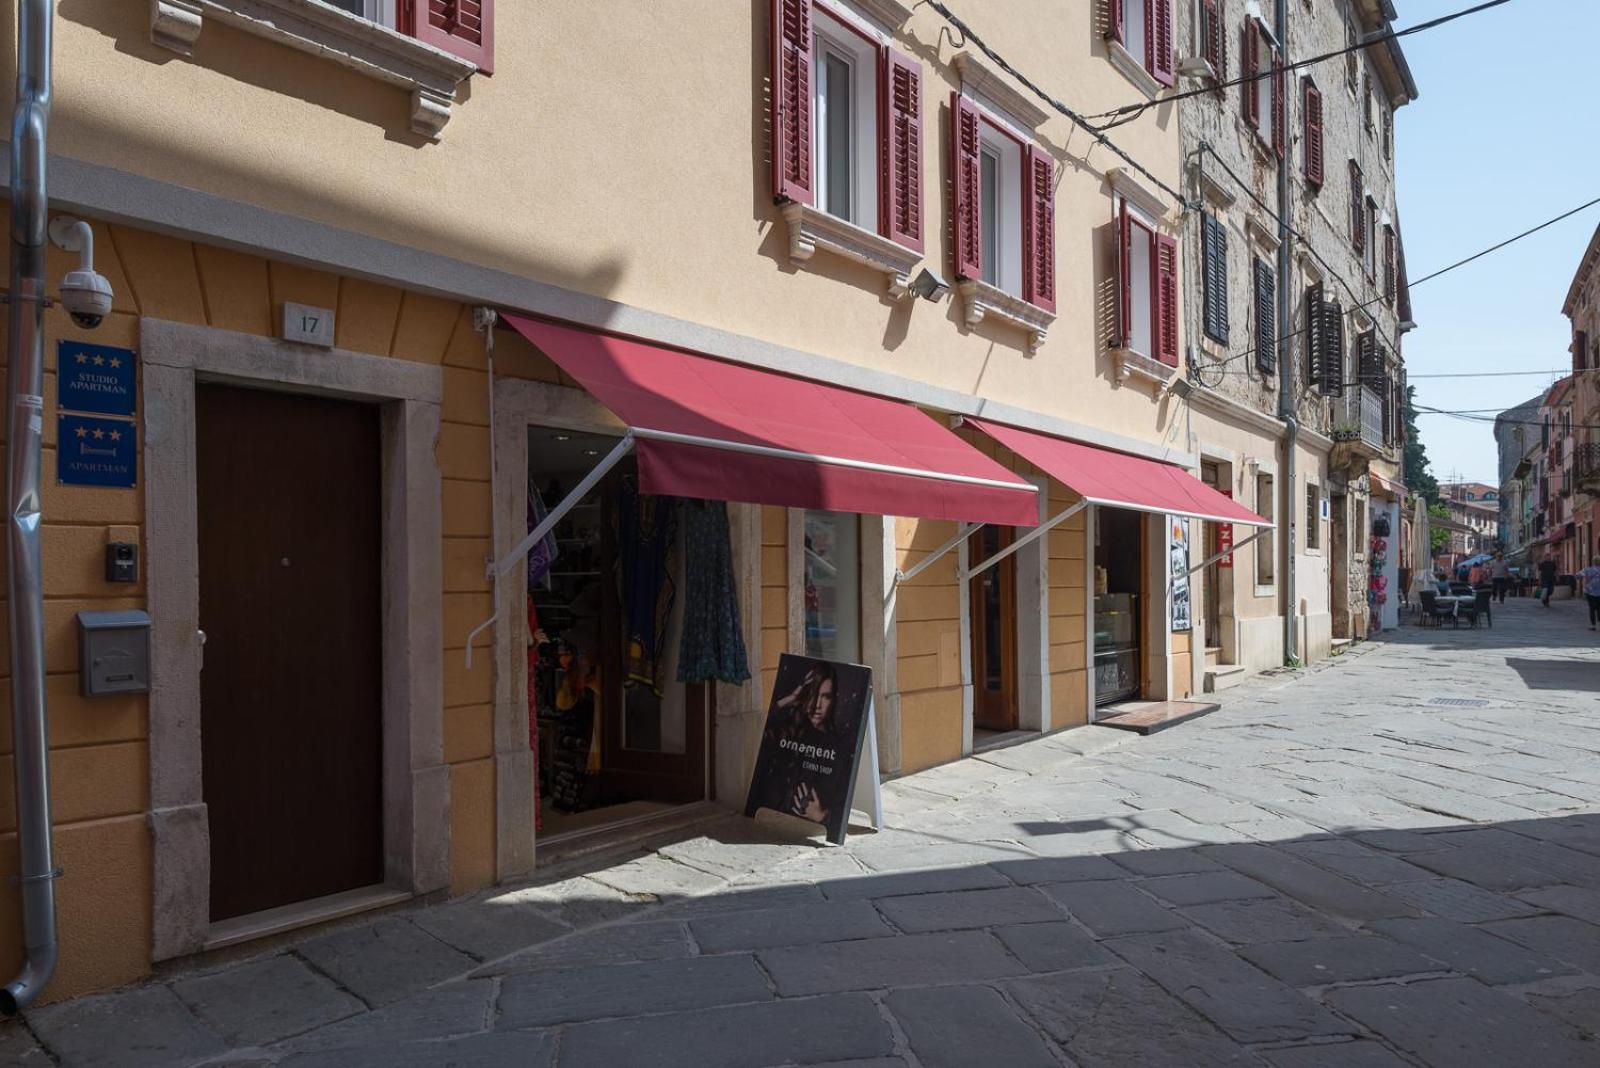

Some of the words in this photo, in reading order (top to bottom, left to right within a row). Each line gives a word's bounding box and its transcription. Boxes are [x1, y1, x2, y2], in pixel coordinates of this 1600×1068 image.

[302, 316, 320, 333] 17
[78, 373, 118, 385] STUDIO
[70, 381, 126, 394] APARTMAN
[68, 462, 127, 473] APARTMAN
[780, 739, 836, 760] ornament
